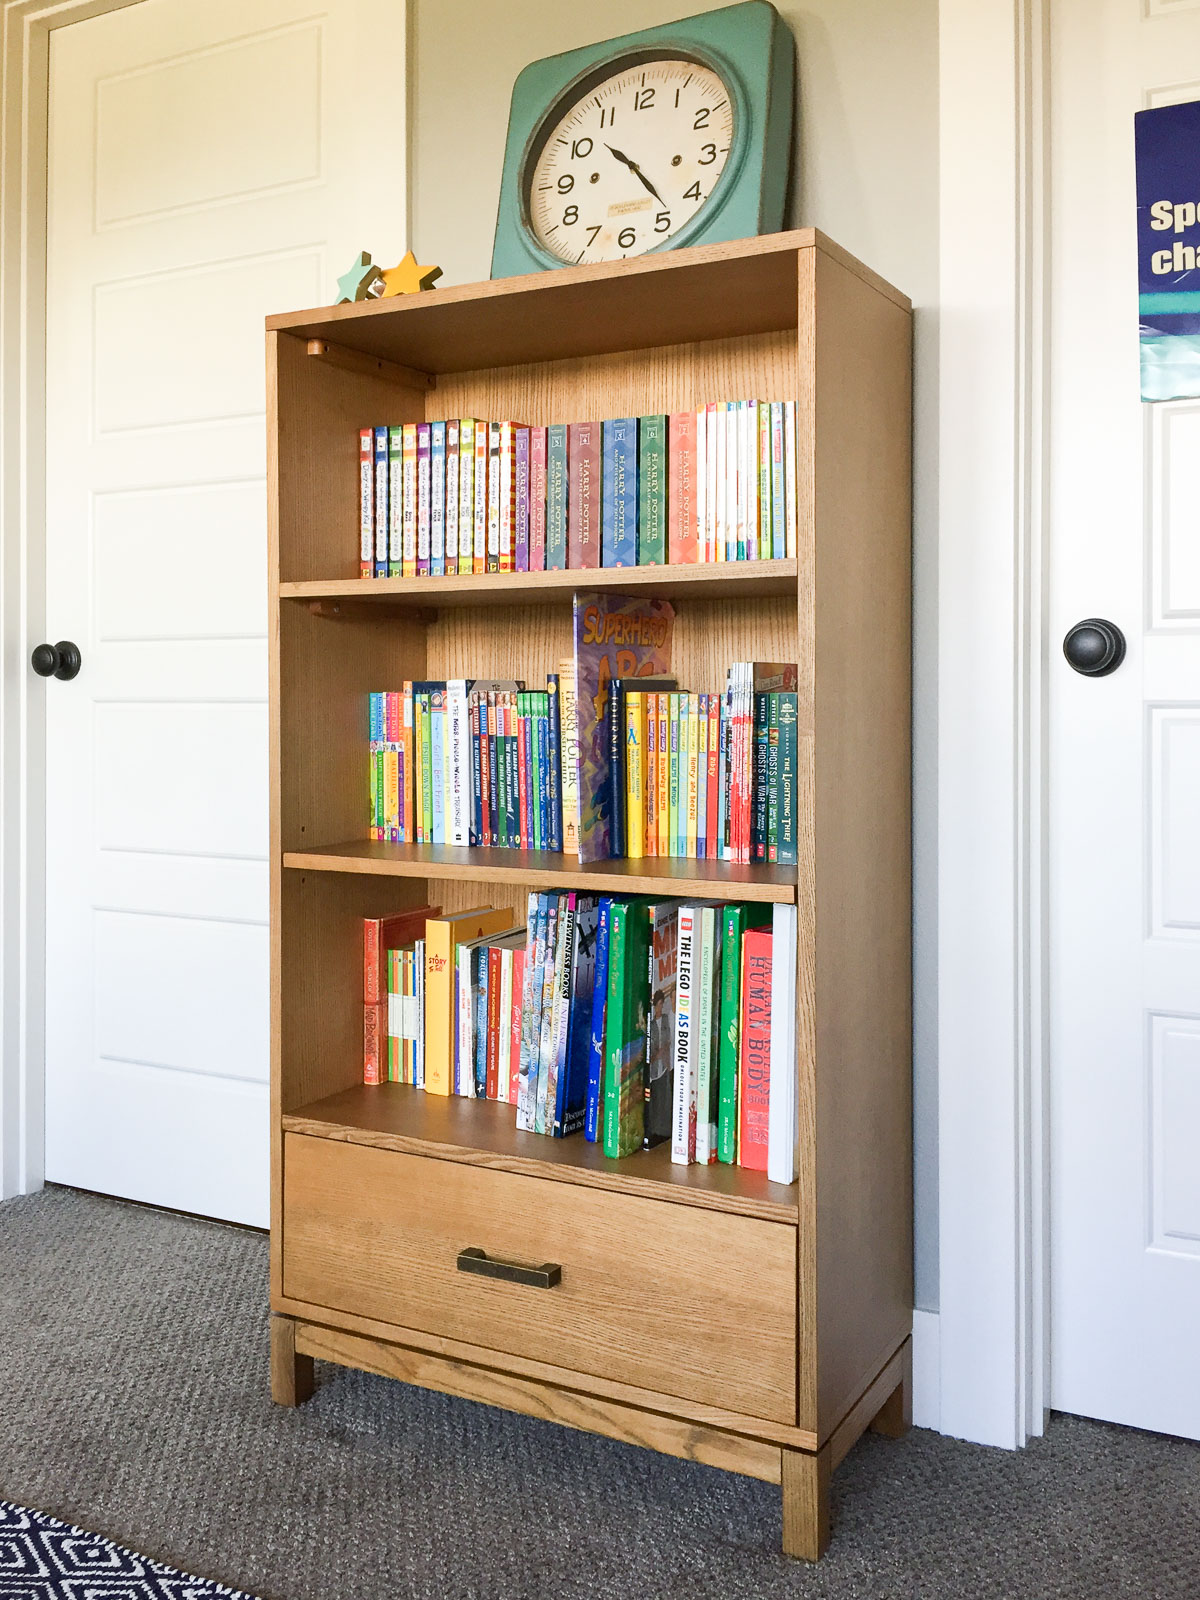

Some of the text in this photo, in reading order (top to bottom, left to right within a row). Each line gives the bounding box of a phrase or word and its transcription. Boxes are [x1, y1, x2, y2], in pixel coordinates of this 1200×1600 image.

[635, 88, 656, 111] 12
[600, 107, 615, 128] 11
[693, 108, 710, 130] 2
[571, 137, 594, 159] 10
[698, 143, 716, 165] 3
[557, 175, 575, 194] 9
[682, 181, 701, 201] 4
[562, 205, 579, 225] 8
[654, 211, 671, 232] 5
[1150, 200, 1200, 233] Sp
[586, 225, 602, 246] 7
[618, 228, 636, 248] 6
[362, 514, 371, 524] Kid
[583, 604, 668, 648] SUPERHERO
[566, 690, 576, 732] HARRY
[567, 738, 577, 788] POTTER
[708, 757, 716, 777] Ribsy
[758, 744, 766, 773] GHOSTS
[769, 747, 777, 776] GHOSTS
[434, 769, 442, 787] Best
[782, 773, 792, 816] LIGHTNING
[782, 818, 792, 842] THIEF
[564, 912, 573, 966] EYEWITNESS
[680, 936, 691, 958] THE
[429, 957, 447, 965] STORY
[562, 968, 571, 997] BOOKS
[679, 960, 691, 990] LEGO
[749, 955, 765, 1029] HUMAN
[678, 994, 689, 1028] IDEAS
[559, 1001, 568, 1045] UNIVERSE
[677, 1030, 688, 1064] BOOK
[748, 1038, 764, 1096] BODY
